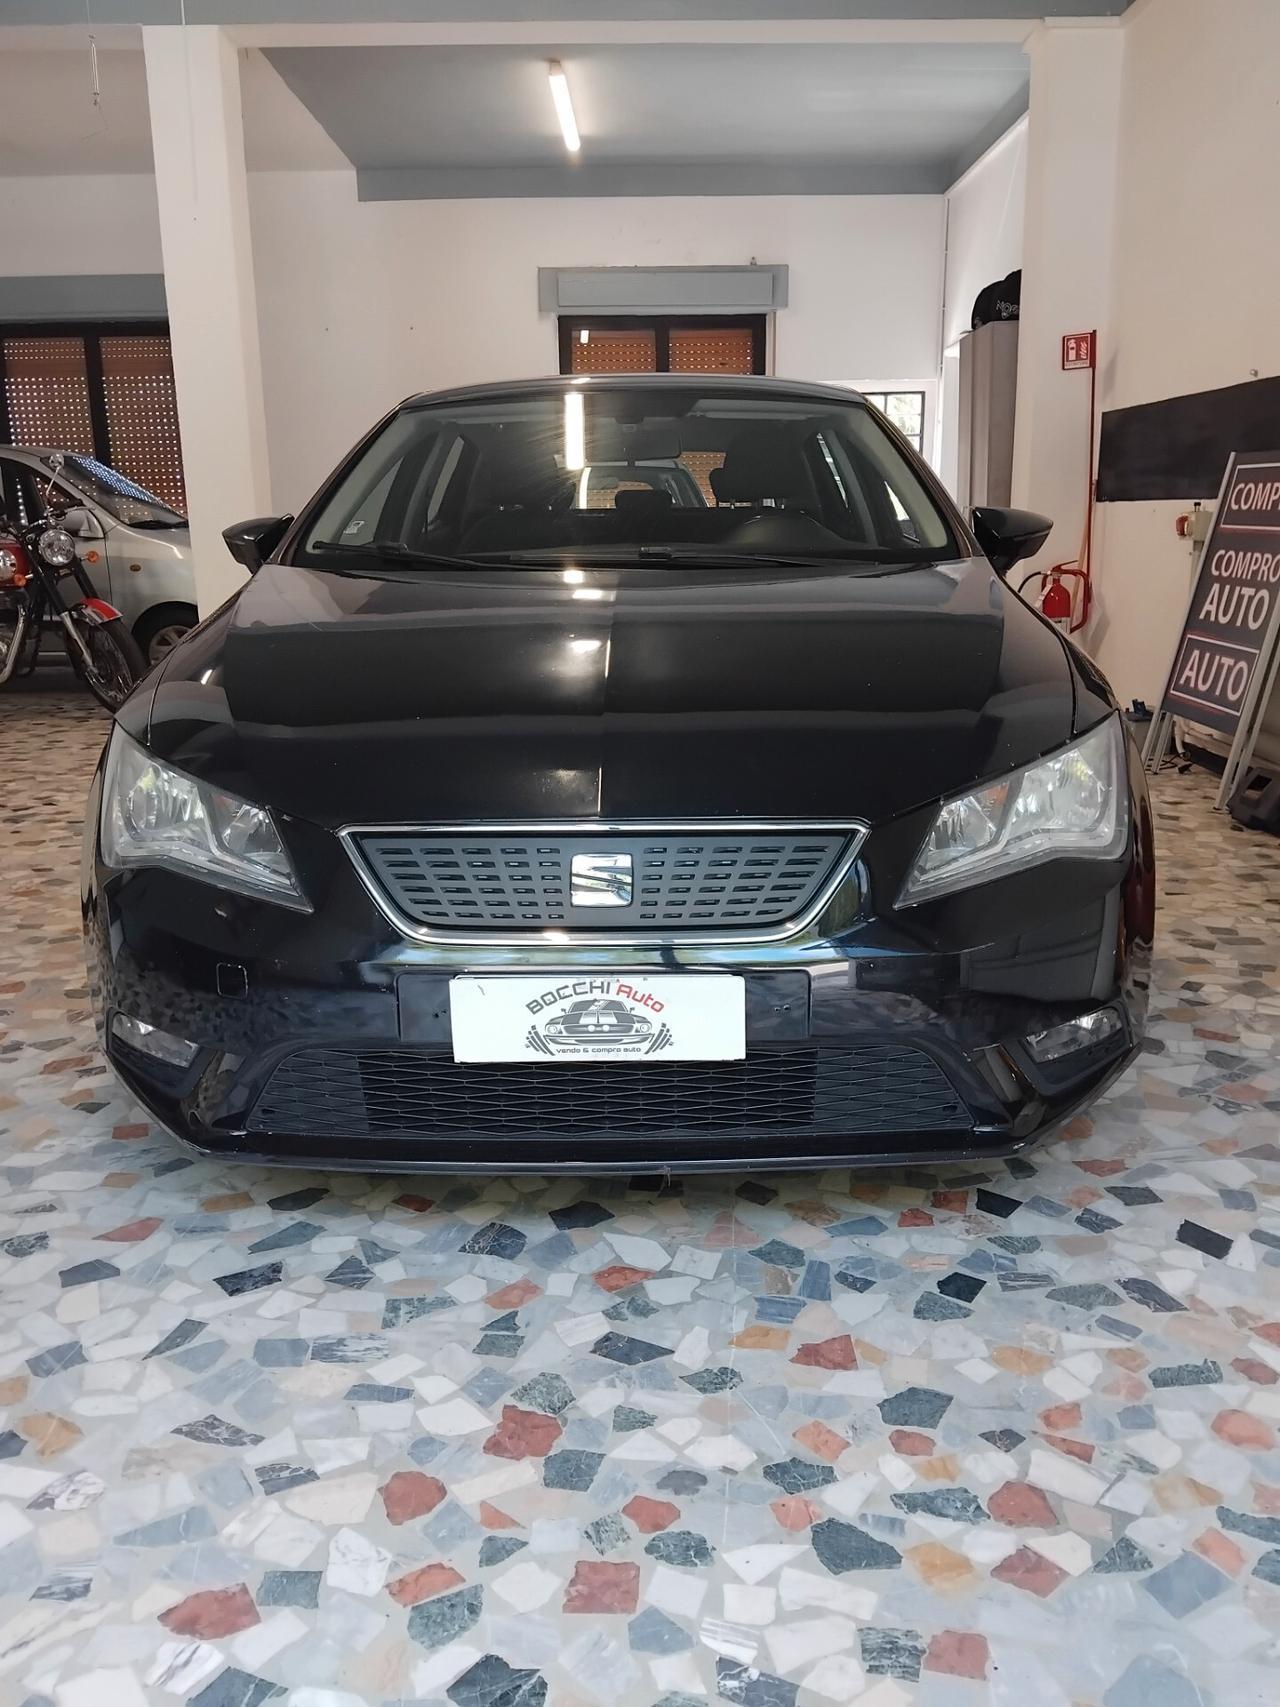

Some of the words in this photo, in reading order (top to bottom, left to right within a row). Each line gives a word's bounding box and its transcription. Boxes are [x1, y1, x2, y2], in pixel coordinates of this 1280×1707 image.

[1231, 482, 1280, 510] COMP
[1211, 549, 1280, 583] COMPRO
[1199, 583, 1270, 630] AUTO
[1180, 649, 1249, 701] AUTO
[526, 981, 611, 1015] BOCCHI
[616, 984, 664, 1013] Auto
